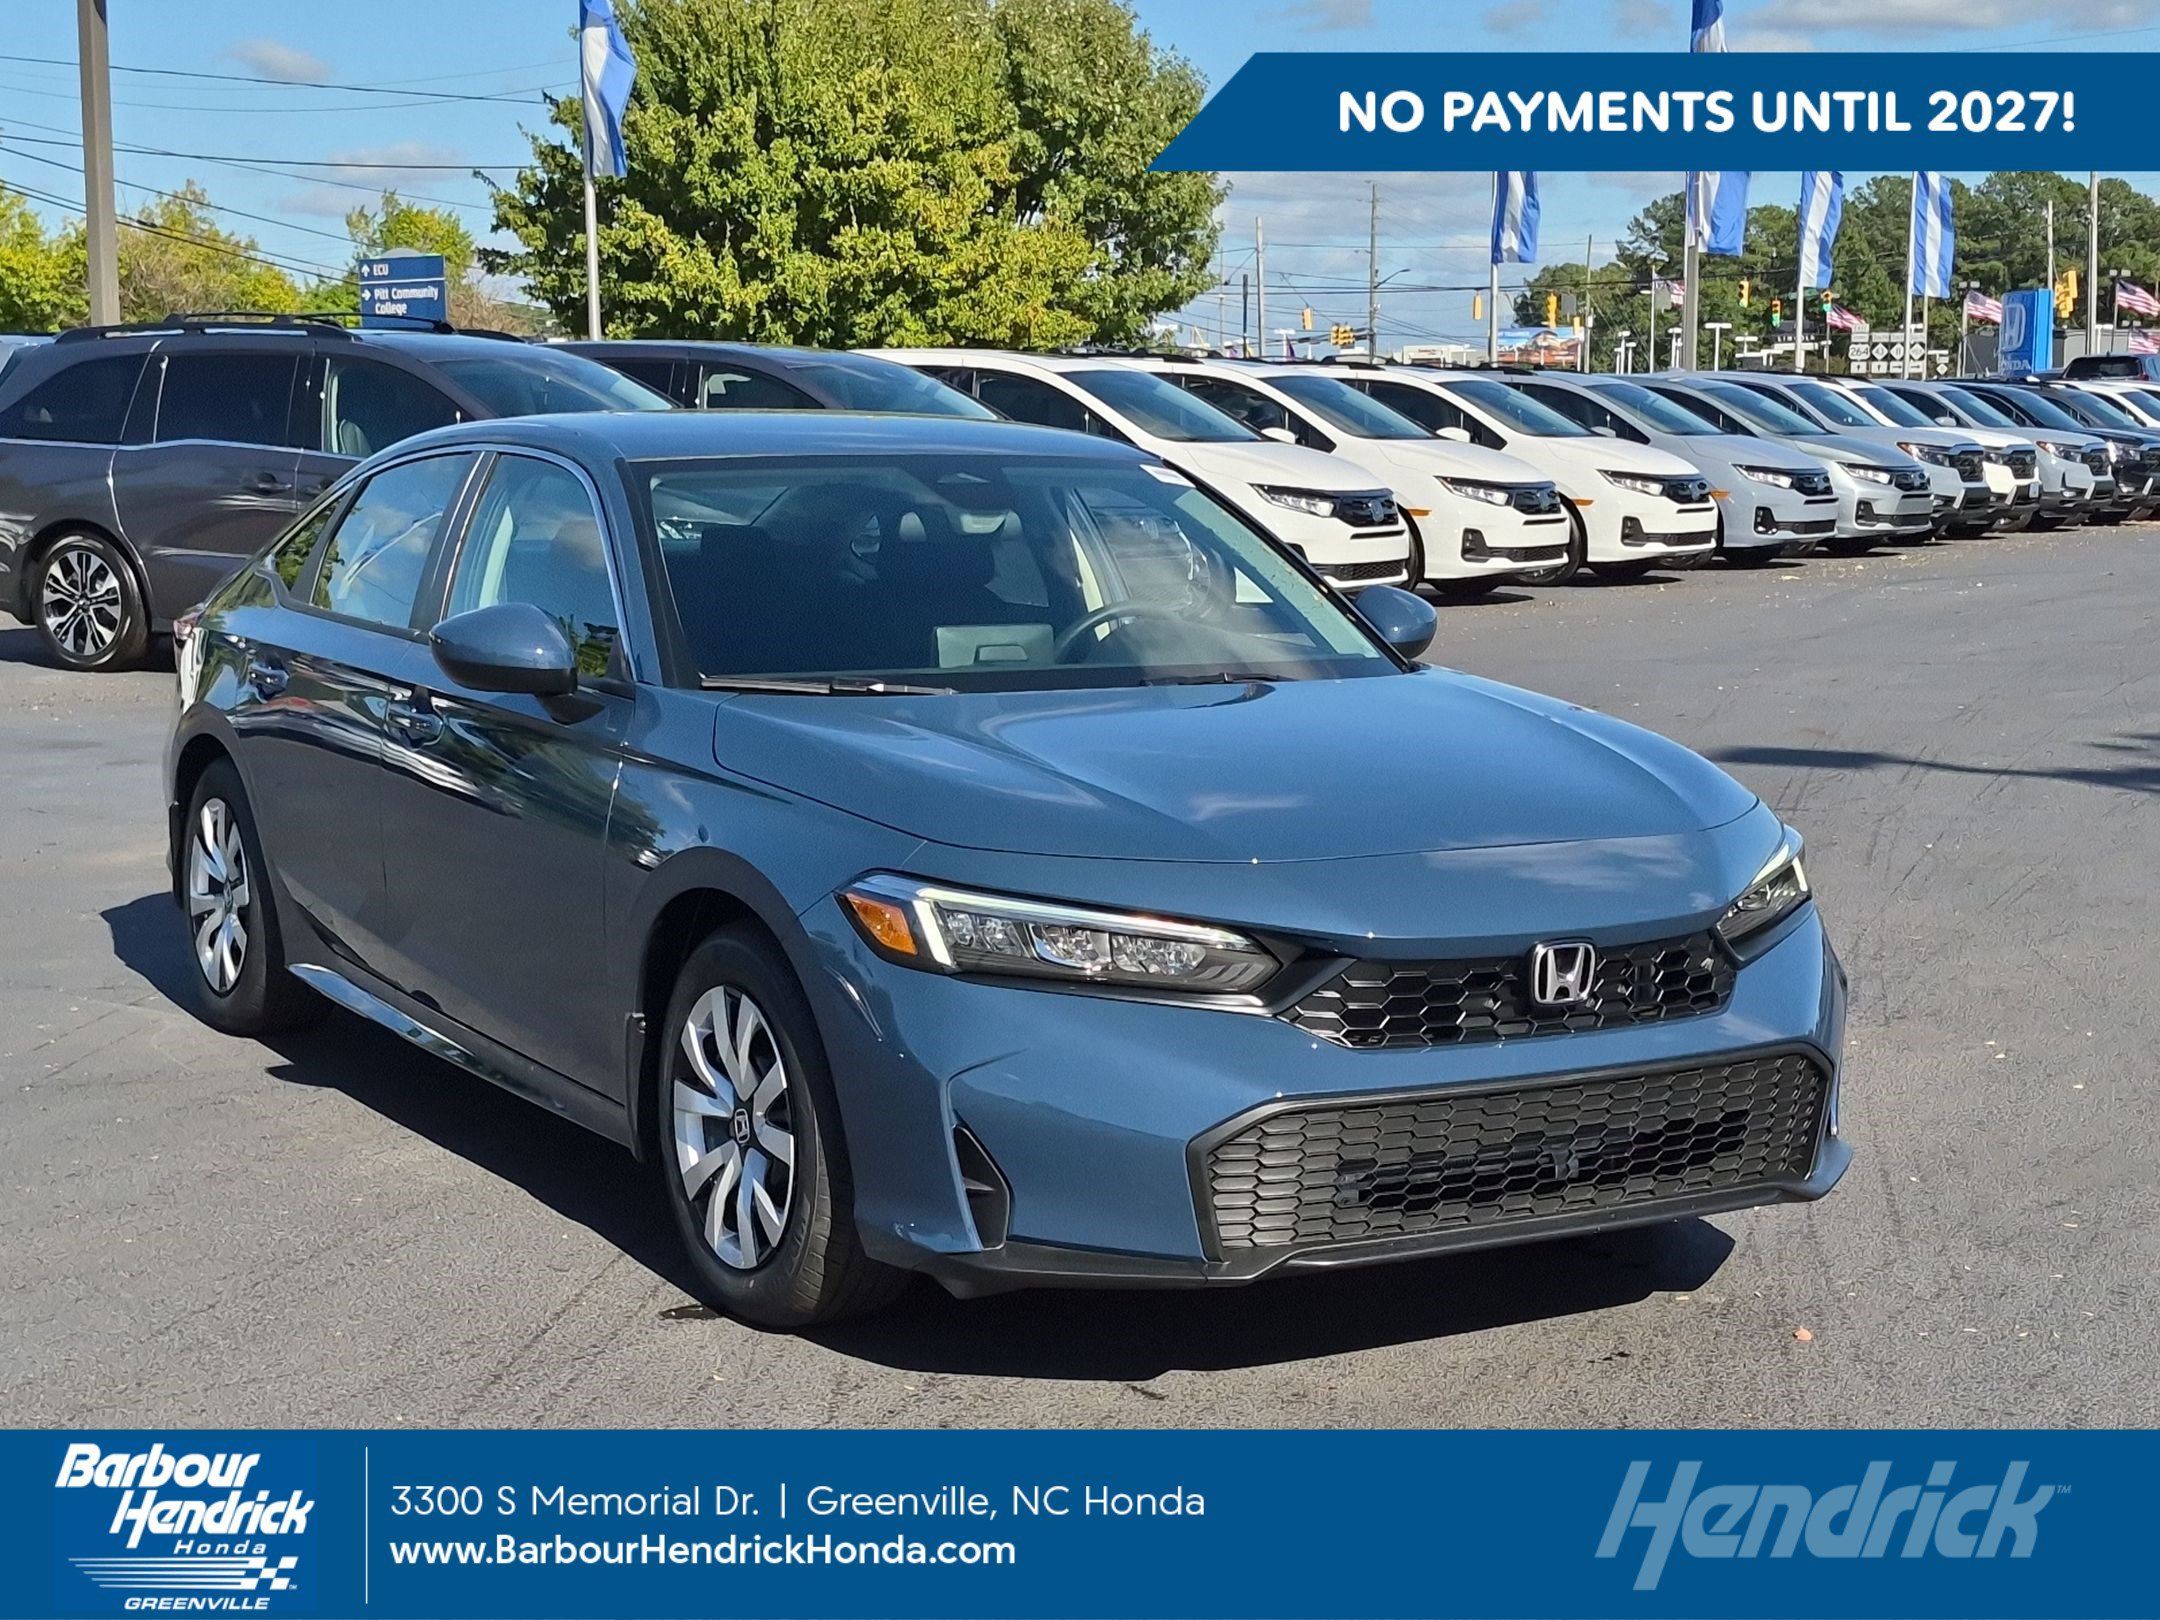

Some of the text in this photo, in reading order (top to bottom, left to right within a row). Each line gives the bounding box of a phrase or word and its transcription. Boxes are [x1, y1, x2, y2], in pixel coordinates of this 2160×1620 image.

[374, 286, 439, 301] Pitt Community
[375, 302, 407, 315] College
[1850, 346, 1869, 356] 264
